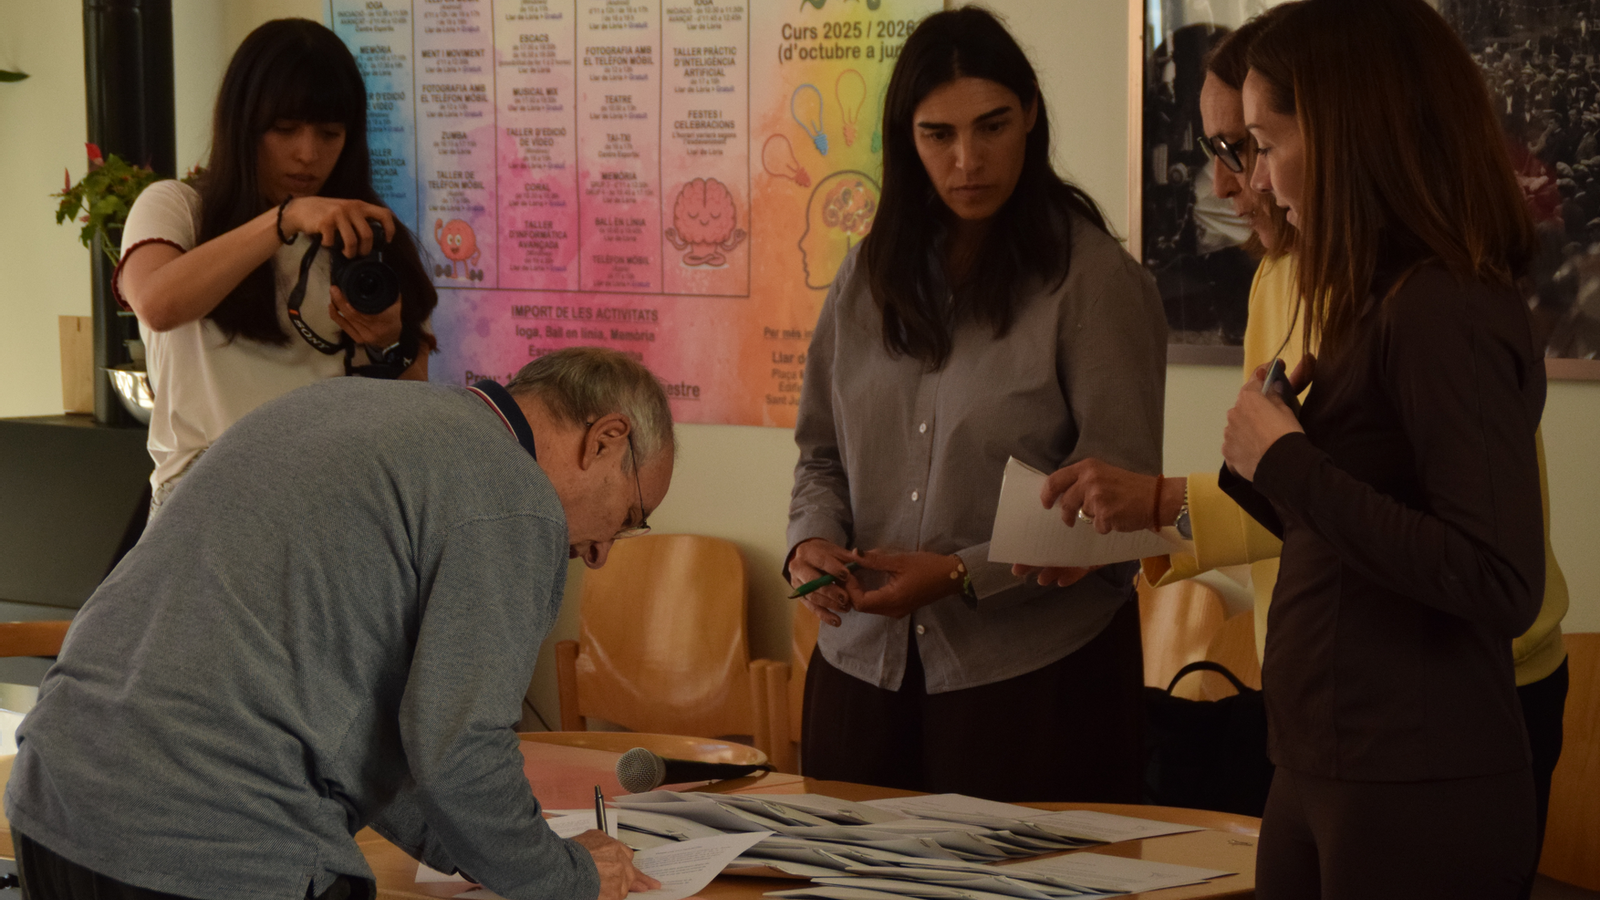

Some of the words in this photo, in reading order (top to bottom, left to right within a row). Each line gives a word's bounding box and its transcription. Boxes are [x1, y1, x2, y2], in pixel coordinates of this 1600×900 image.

[782, 23, 818, 40] Curs
[823, 22, 862, 39] 2025
[866, 21, 872, 38] /
[520, 34, 549, 43] ESCACS
[446, 49, 485, 57] MOVIMENT
[585, 46, 632, 55] FOTOGRAFIA
[635, 45, 652, 54] AMB
[673, 47, 701, 56] TALLER
[703, 45, 737, 55] PRÀCTIC
[778, 42, 861, 65] (d'octubre
[866, 45, 875, 58] a
[584, 57, 593, 66] EL
[595, 56, 628, 66] TELÈFON
[684, 68, 726, 77] ARTIFICIAL
[422, 84, 467, 93] FOTOGRAFIA
[470, 84, 486, 92] AMB
[513, 88, 544, 96] MUSICAL
[421, 95, 429, 103] EL
[604, 95, 632, 104] TEATRE
[688, 110, 718, 119] FESTES
[674, 120, 735, 129] CELEBRACIONS
[442, 131, 467, 139] ZUMBA
[506, 127, 533, 136] TALLER
[519, 138, 529, 146] DE
[370, 149, 392, 157] ALLER
[437, 171, 462, 179] TALLER
[601, 171, 637, 180] MEMÒRIA
[525, 183, 551, 191] CORAL
[525, 220, 553, 229] TALLER
[595, 217, 612, 226] BALL
[614, 217, 624, 226] EN
[511, 305, 553, 318] IMPORT
[555, 307, 569, 318] DE
[572, 307, 593, 319] LES
[595, 307, 659, 321] ACTIVITATS
[294, 319, 331, 350] SONY
[515, 325, 542, 339] Ioga,
[545, 326, 563, 338] Ball
[566, 329, 578, 338] en
[772, 351, 795, 364] Llar
